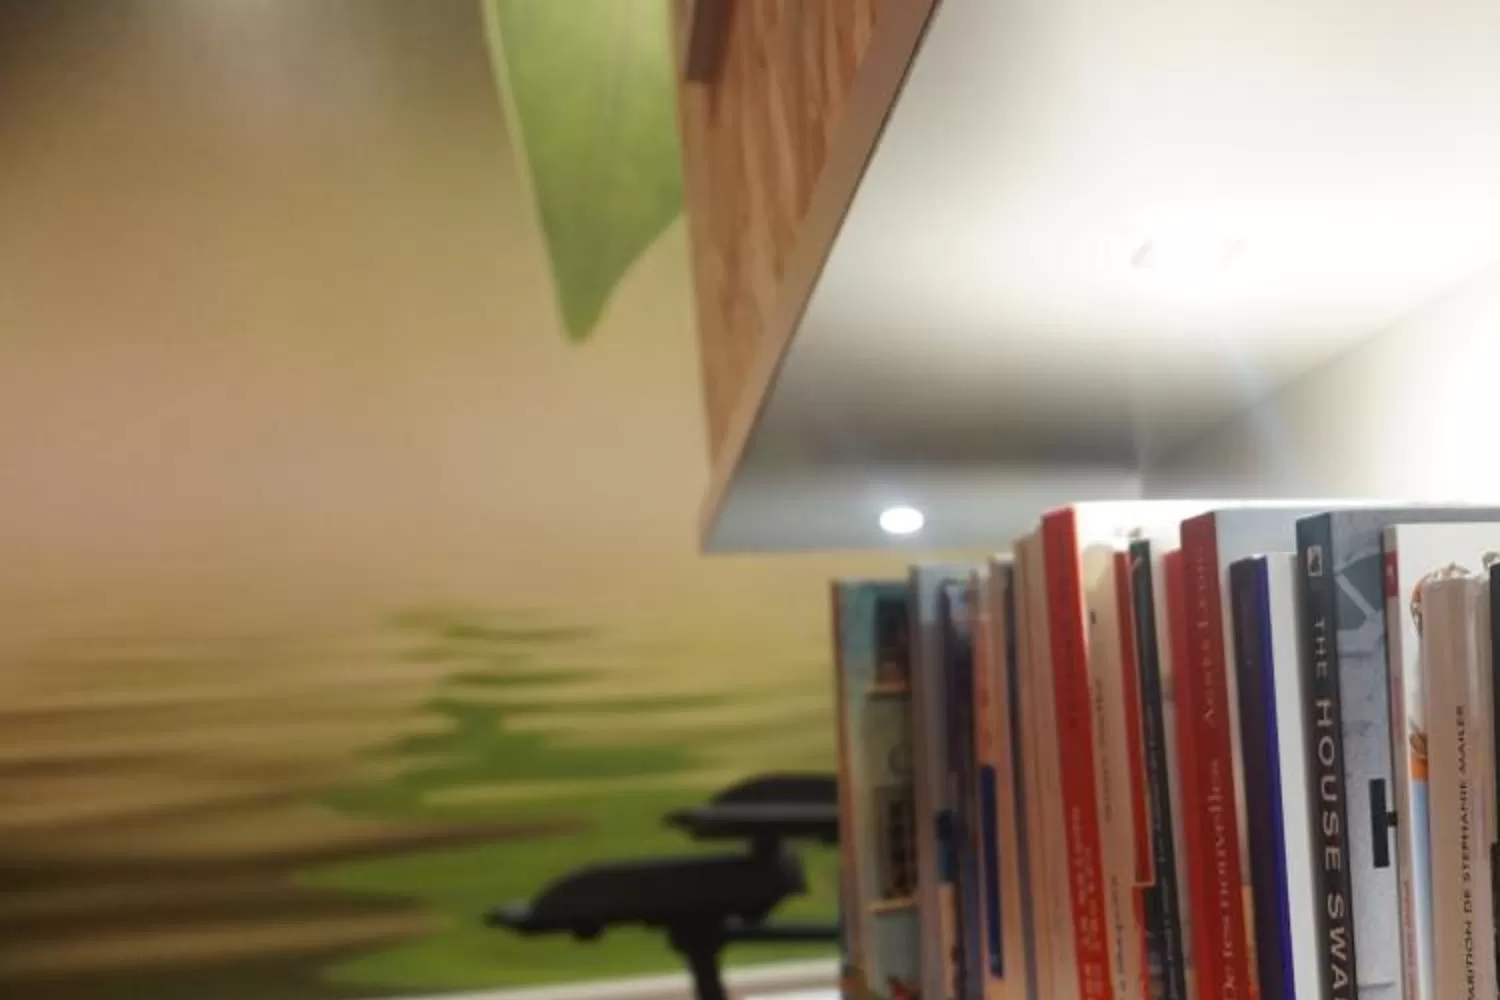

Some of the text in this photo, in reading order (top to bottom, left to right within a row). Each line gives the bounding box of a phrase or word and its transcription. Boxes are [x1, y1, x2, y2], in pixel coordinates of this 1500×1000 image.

[1314, 617, 1328, 680] THE
[1316, 700, 1341, 872] HOUSE
[1464, 887, 1472, 913] DE
